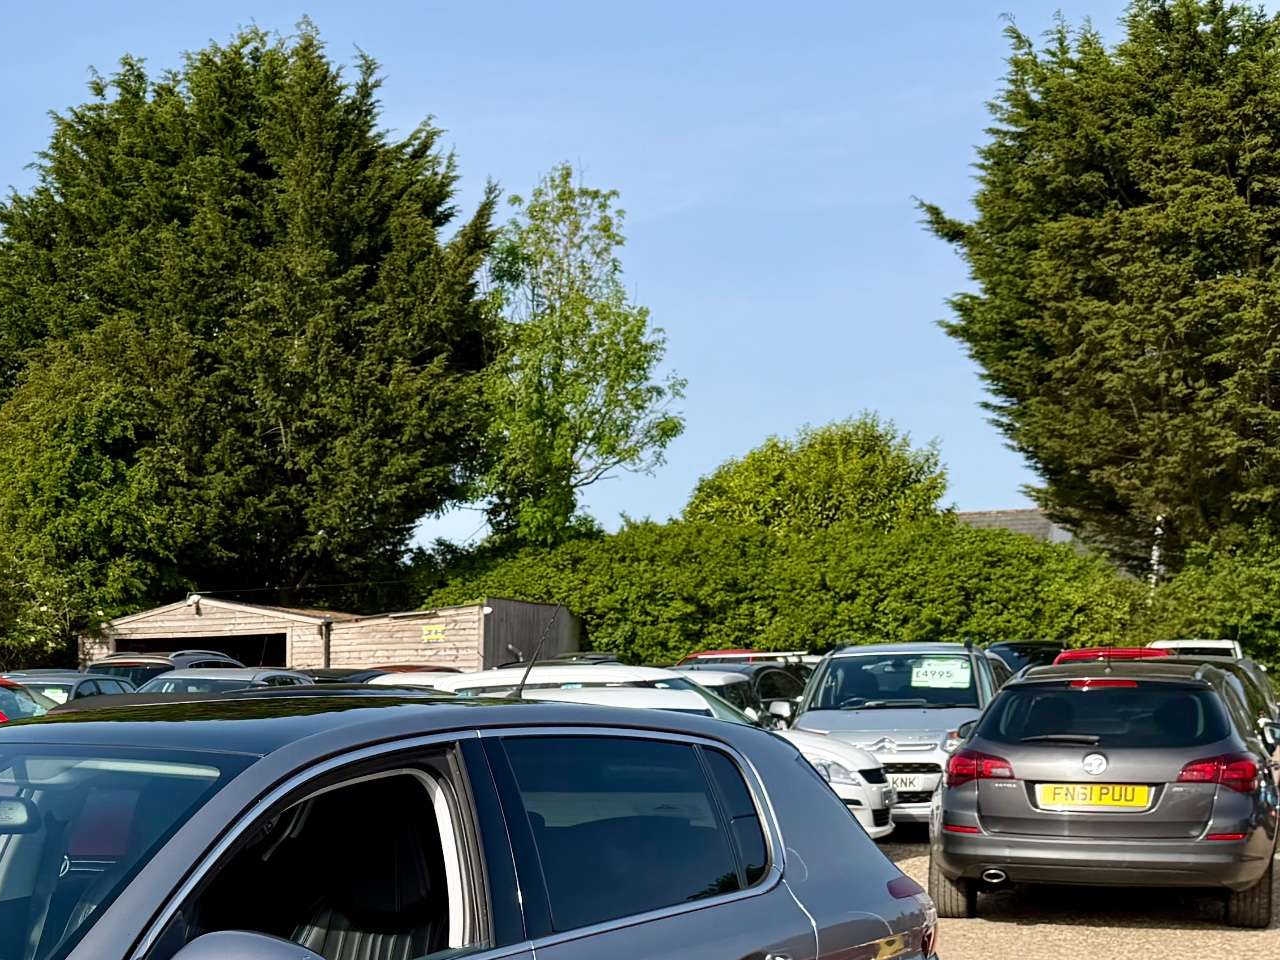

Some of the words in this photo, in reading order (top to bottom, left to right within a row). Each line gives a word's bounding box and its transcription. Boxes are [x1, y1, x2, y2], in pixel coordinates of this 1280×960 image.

[915, 669, 953, 679] £4995
[891, 776, 917, 788] KNK
[1052, 786, 1093, 801] FN61
[1099, 786, 1136, 802] PUU
